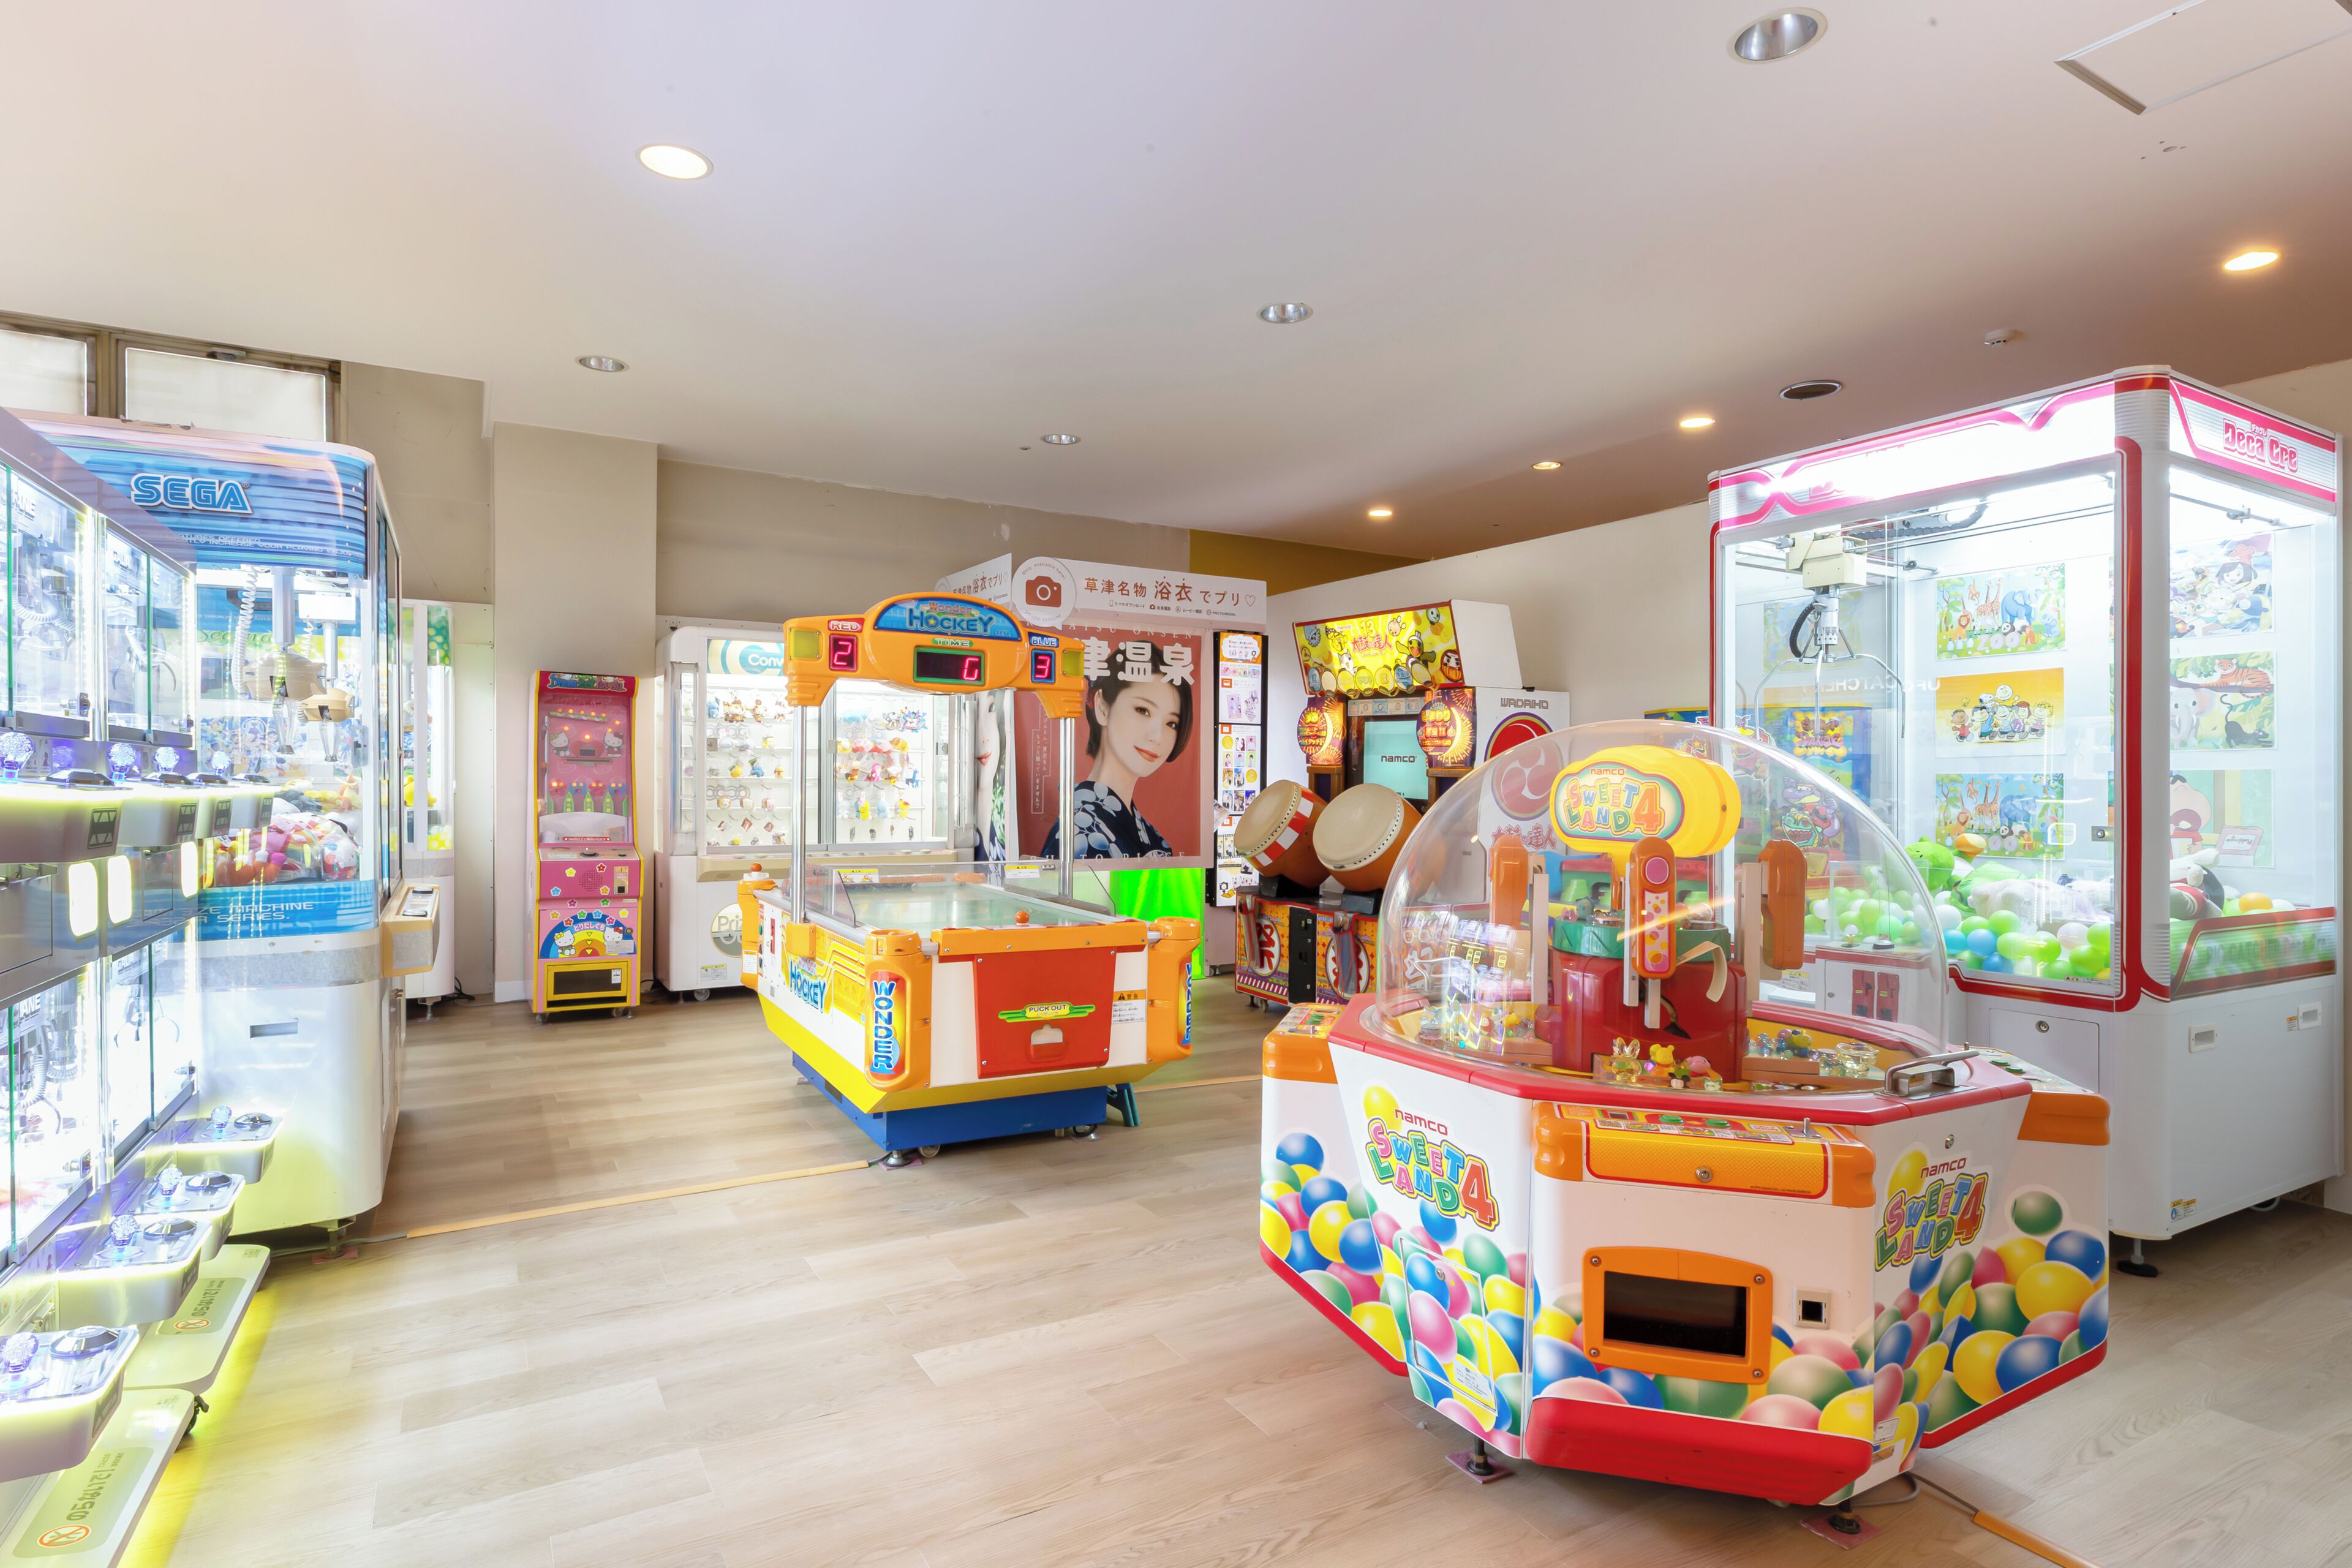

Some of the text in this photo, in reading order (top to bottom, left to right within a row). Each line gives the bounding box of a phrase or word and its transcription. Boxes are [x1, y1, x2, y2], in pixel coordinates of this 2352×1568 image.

[2223, 418, 2298, 473] Deca Cre
[130, 473, 253, 514] SEGA
[928, 601, 973, 614] Wonder
[830, 620, 861, 631] RED
[908, 608, 996, 635] HOCKEY
[1360, 619, 1377, 638] 13
[833, 641, 852, 665] 2
[934, 638, 971, 647] TIME
[1031, 636, 1057, 647] BLUE
[1351, 634, 1393, 654] 太鼓の達人
[1976, 633, 2021, 651] ZOO
[1035, 655, 1050, 678] 3
[1381, 755, 1416, 763] namco
[1569, 779, 1640, 810] SWEET
[1565, 785, 1664, 833] LAND 4
[228, 902, 314, 913] MACHINE
[573, 921, 606, 932] とりだしぐち
[790, 957, 826, 1014] HOCKEY
[873, 981, 897, 1069] WONDER
[1395, 1109, 1449, 1136] namco
[1370, 1121, 1465, 1185] SWEET
[1920, 1157, 1967, 1179] namco
[1368, 1146, 1496, 1227] LAND 4
[1886, 1177, 1973, 1239] SWEET
[1876, 1176, 1986, 1267] LAND 4
